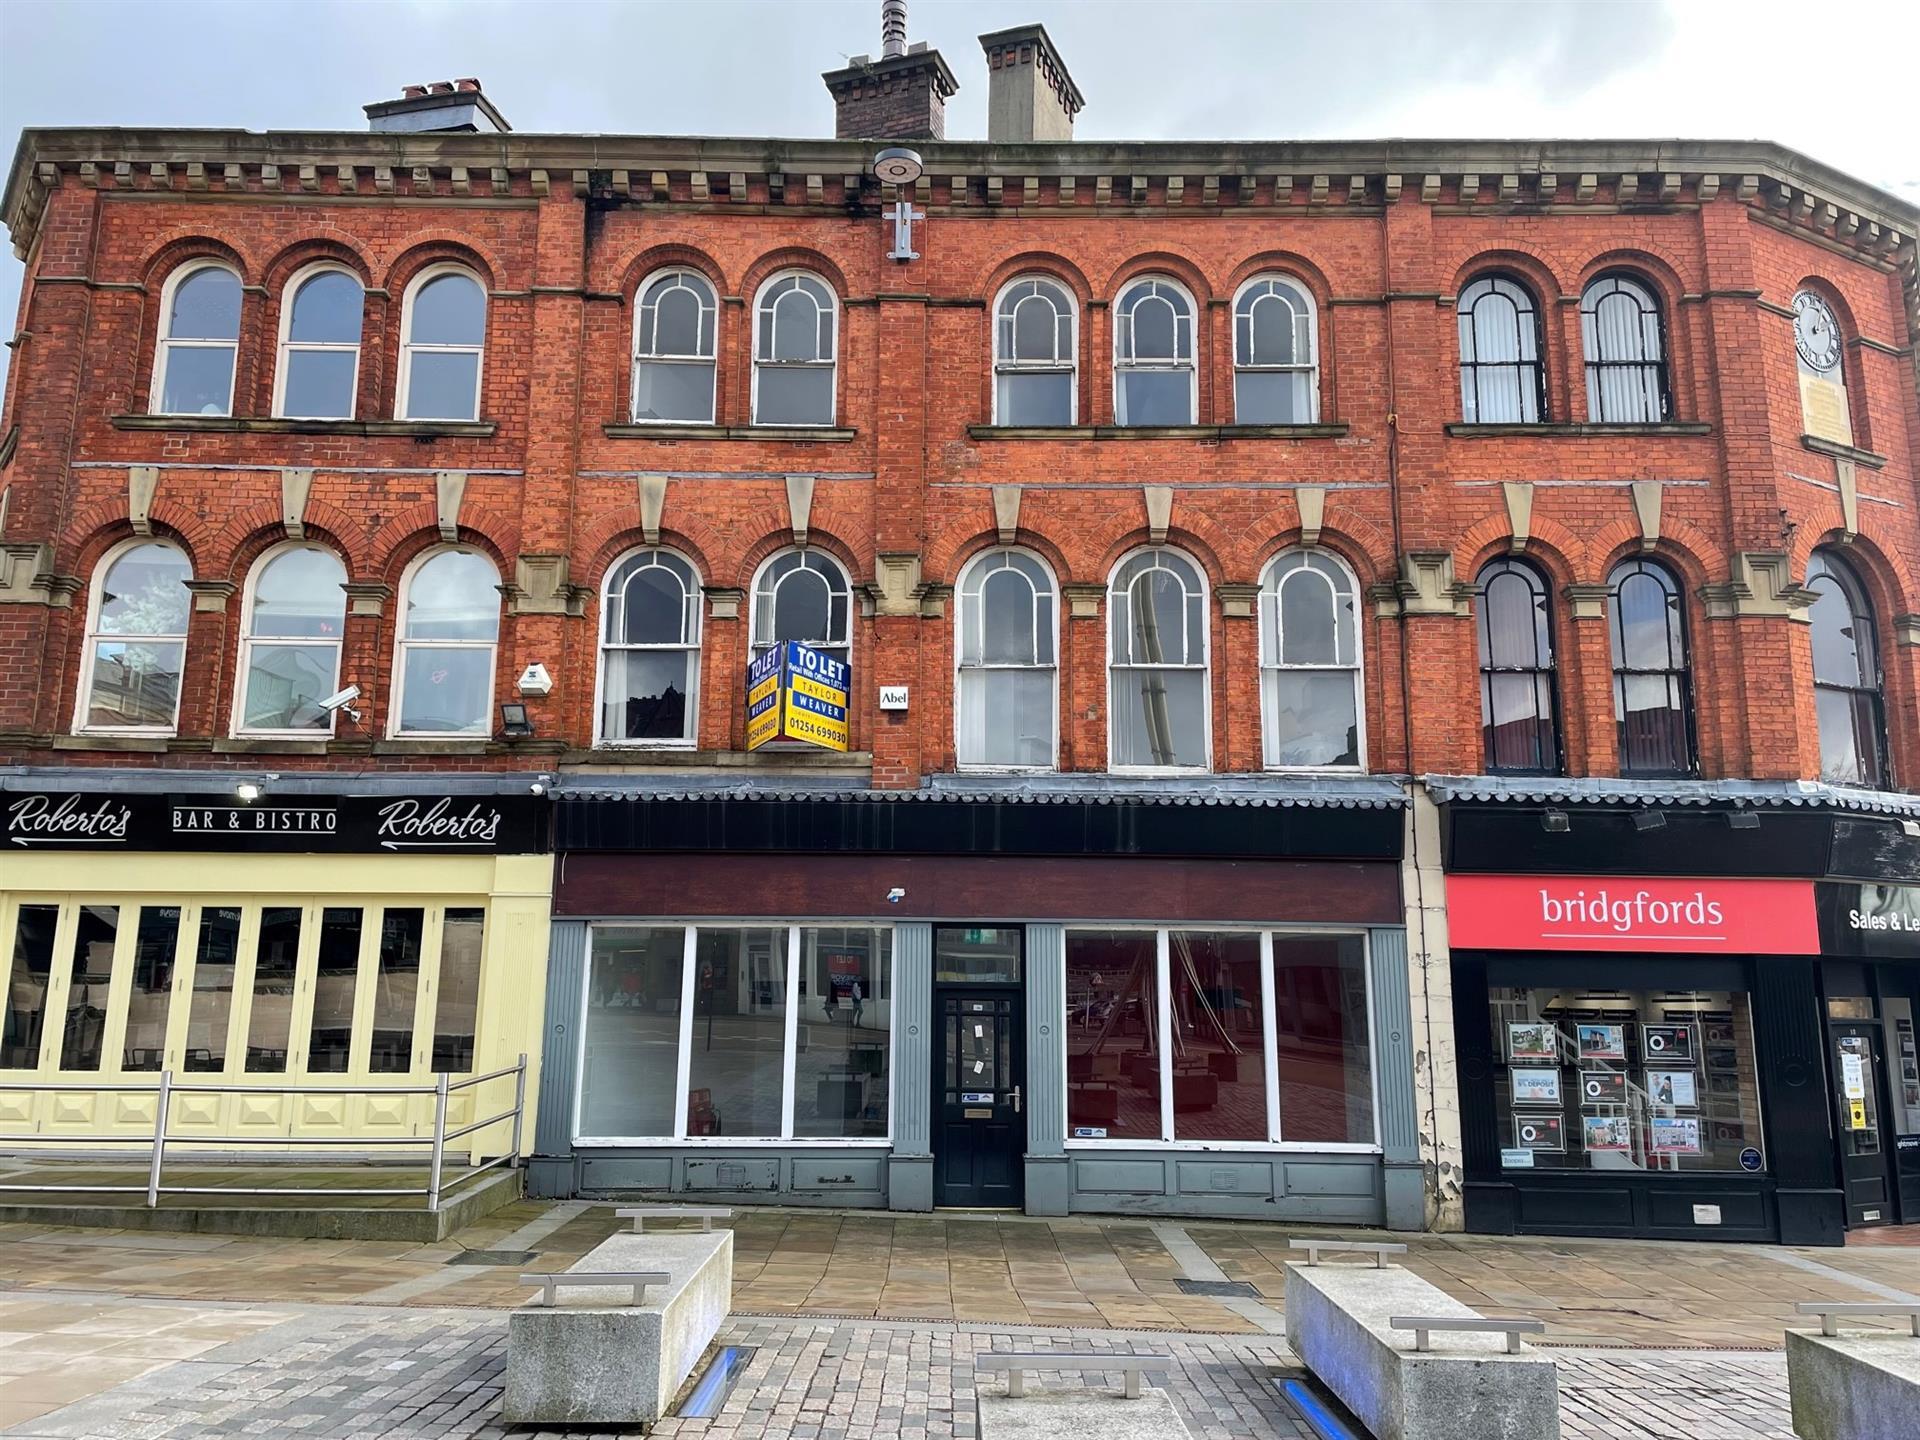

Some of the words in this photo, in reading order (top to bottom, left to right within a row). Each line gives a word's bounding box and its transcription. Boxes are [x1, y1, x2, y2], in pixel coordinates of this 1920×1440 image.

[751, 662, 761, 680] TO
[762, 647, 778, 671] LET
[789, 662, 802, 674] Retail
[803, 667, 814, 678] With
[814, 671, 830, 684] Offices
[797, 646, 817, 670] TO
[820, 656, 845, 681] LET
[753, 682, 772, 699] TAYLOR
[803, 681, 837, 701] TAYLOR
[882, 692, 906, 703] Abel
[751, 695, 772, 717] WEAVER
[799, 695, 839, 717] WEAVER
[789, 718, 815, 734] 01254
[816, 727, 846, 743] 699030
[8, 793, 131, 836] Roberto's
[173, 811, 213, 828] BAR
[229, 812, 239, 828] &
[256, 812, 336, 829] BISTRO
[378, 797, 501, 839] Roberto's
[1539, 889, 1723, 931] bridgfords
[1849, 909, 1887, 930] Sales
[1890, 912, 1901, 930] &
